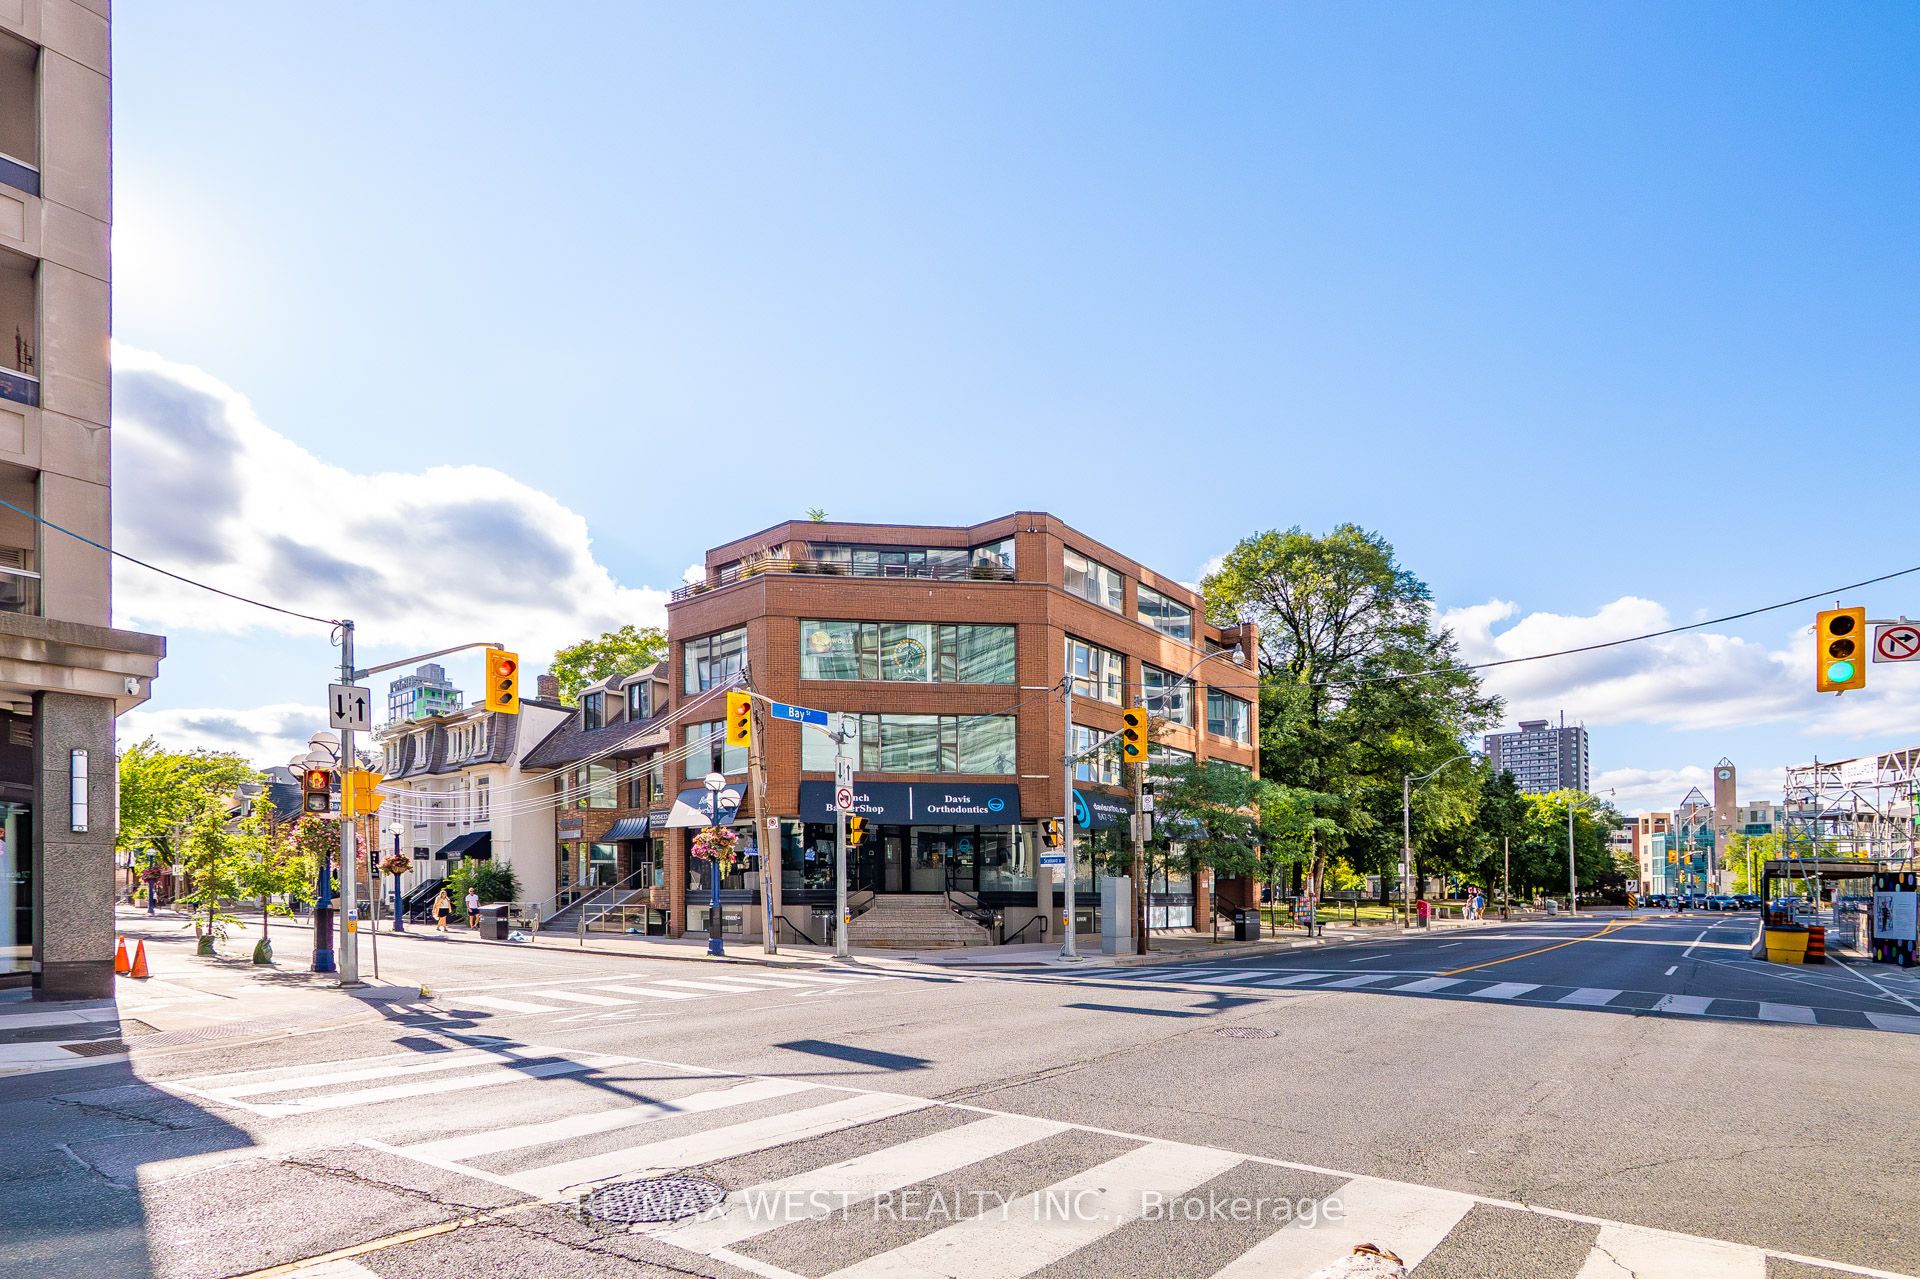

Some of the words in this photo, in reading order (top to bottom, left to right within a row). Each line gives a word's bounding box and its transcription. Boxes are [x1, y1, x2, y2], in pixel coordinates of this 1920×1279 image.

[788, 706, 805, 721] Bay
[805, 709, 812, 717] St
[944, 795, 971, 804] Davis
[330, 802, 341, 811] Bay
[825, 803, 884, 815] BaerShop
[927, 804, 989, 814] Orthodontics
